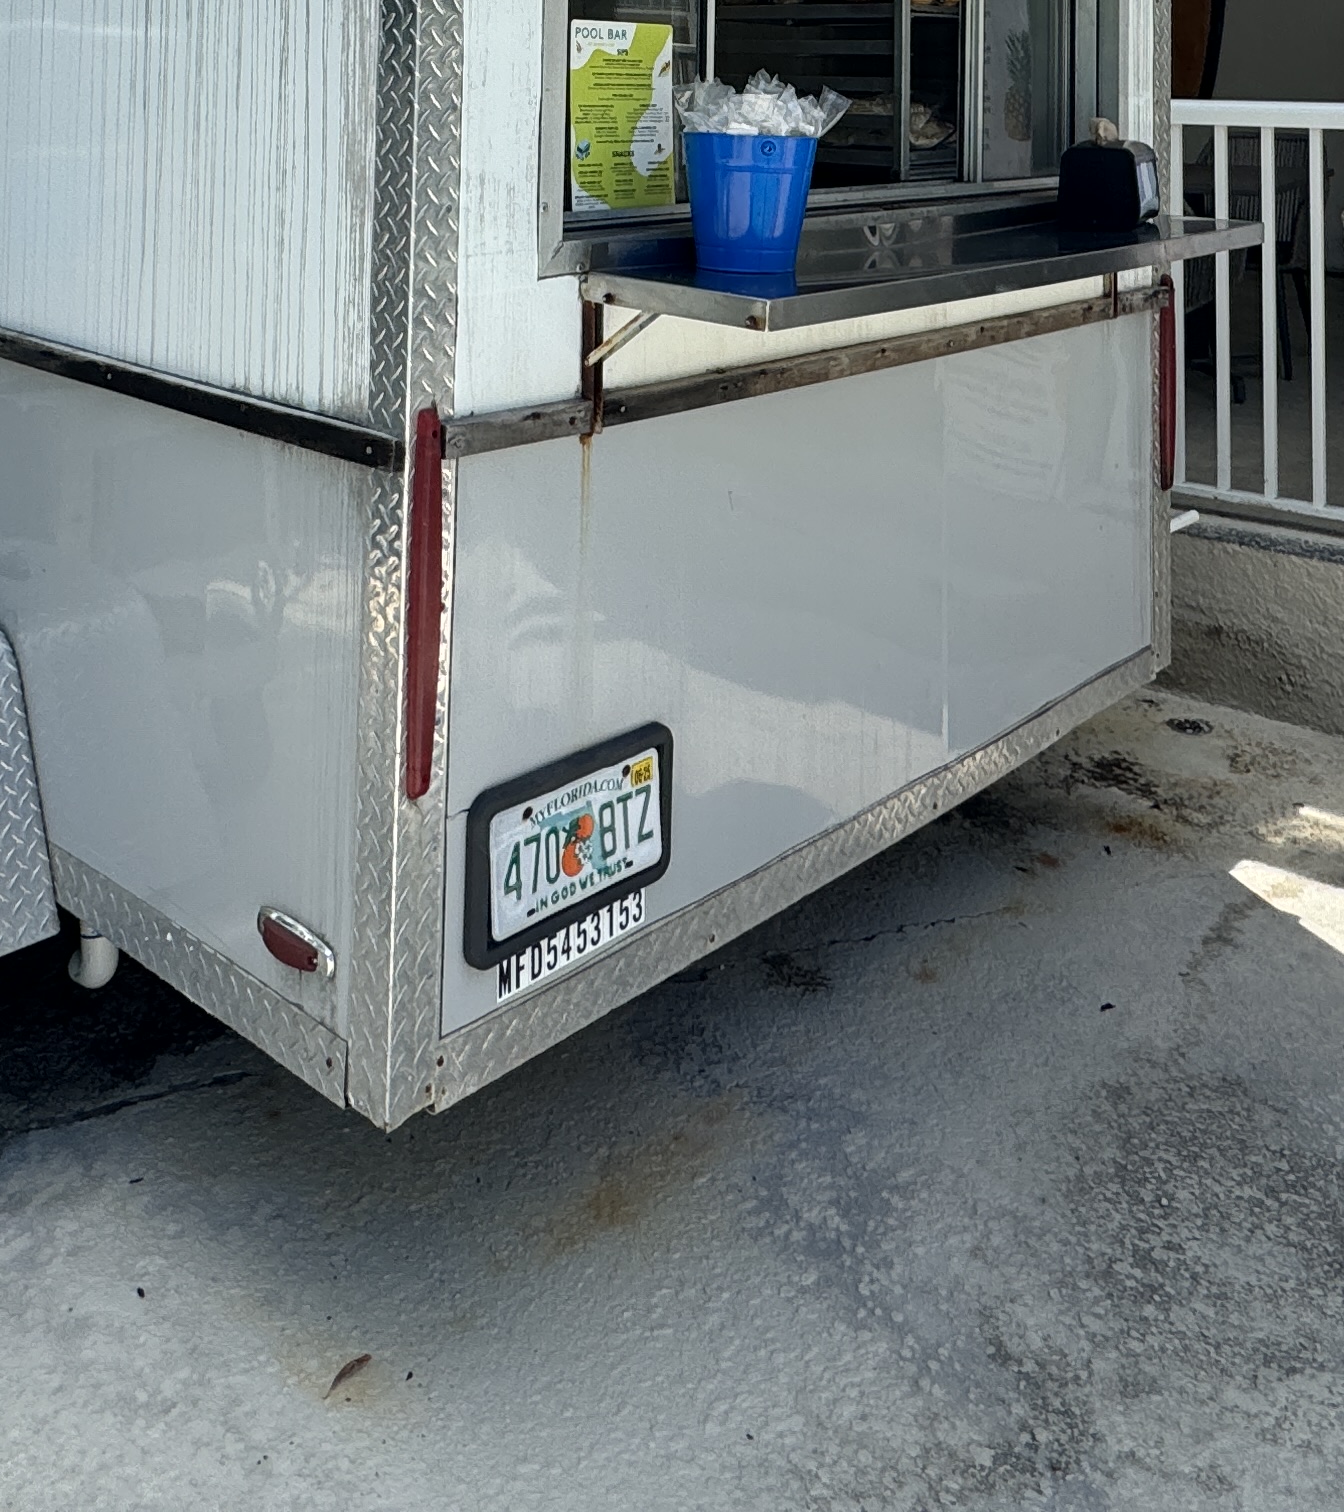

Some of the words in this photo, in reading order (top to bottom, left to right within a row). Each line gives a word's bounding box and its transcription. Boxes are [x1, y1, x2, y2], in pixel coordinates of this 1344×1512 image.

[575, 27, 604, 39] POOL
[608, 29, 627, 40] BAR
[504, 826, 561, 901] 470
[535, 896, 547, 912] IN
[550, 881, 576, 905] GOD
[579, 873, 595, 890] WE
